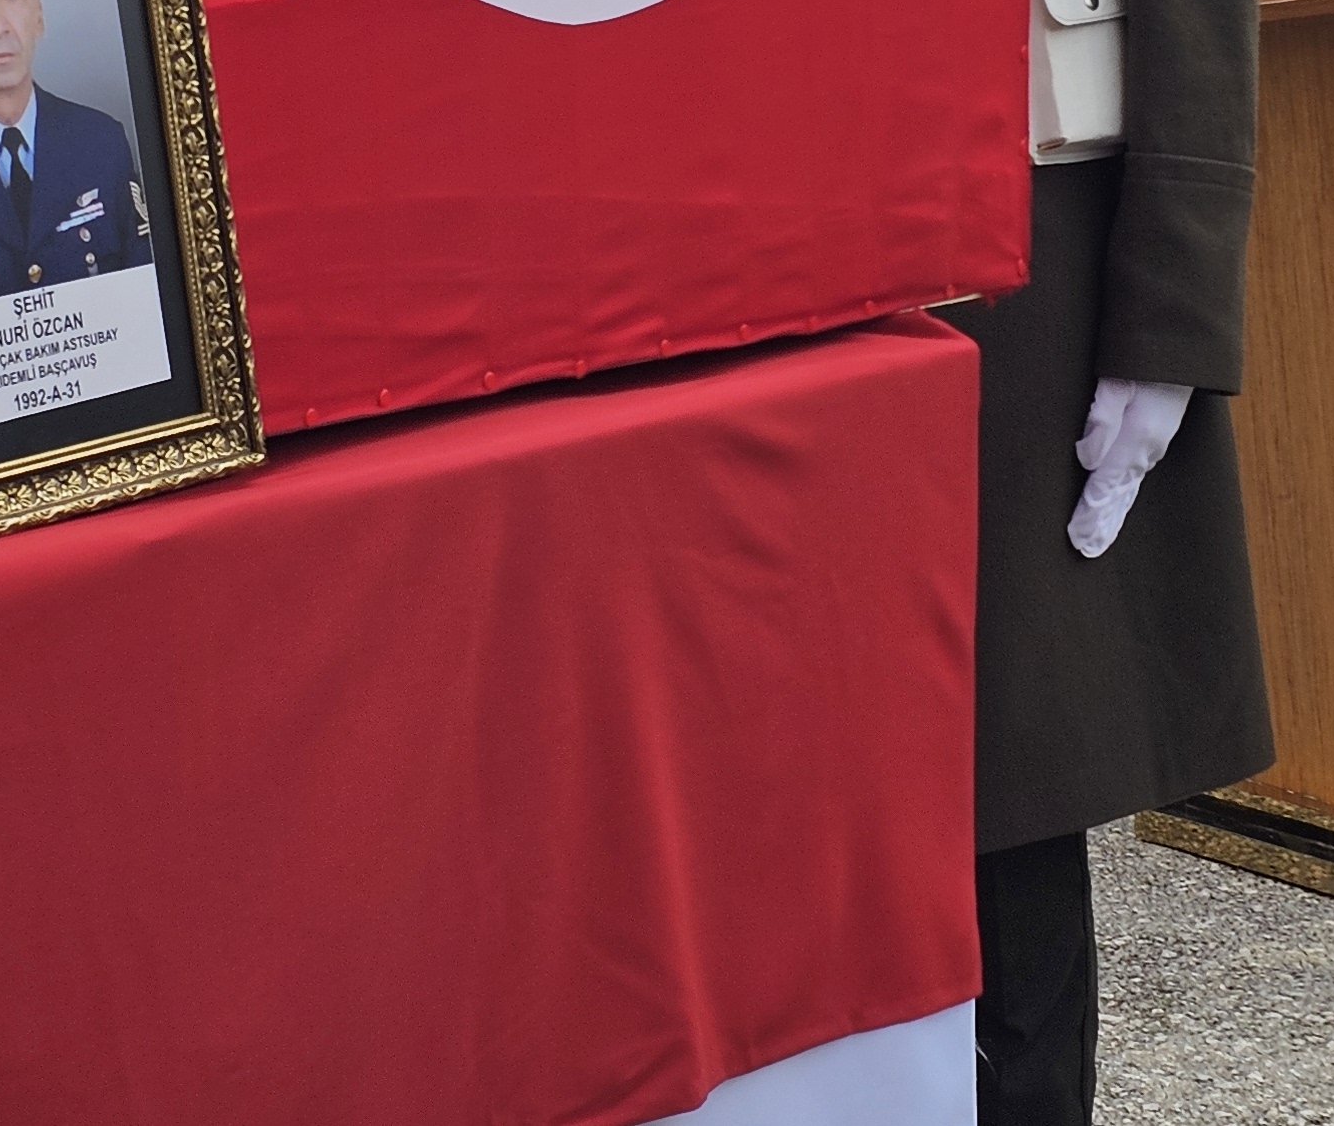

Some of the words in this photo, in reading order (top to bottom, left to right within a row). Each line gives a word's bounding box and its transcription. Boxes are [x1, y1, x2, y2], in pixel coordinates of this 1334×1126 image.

[13, 289, 55, 319] ŞEHİT
[32, 311, 84, 339] ÖZCAN
[26, 342, 60, 362] BAKIM
[62, 328, 118, 353] ASTSUBAY
[38, 353, 97, 379] BAŞÇAVUŞ
[14, 380, 82, 411] 1992-A-31
